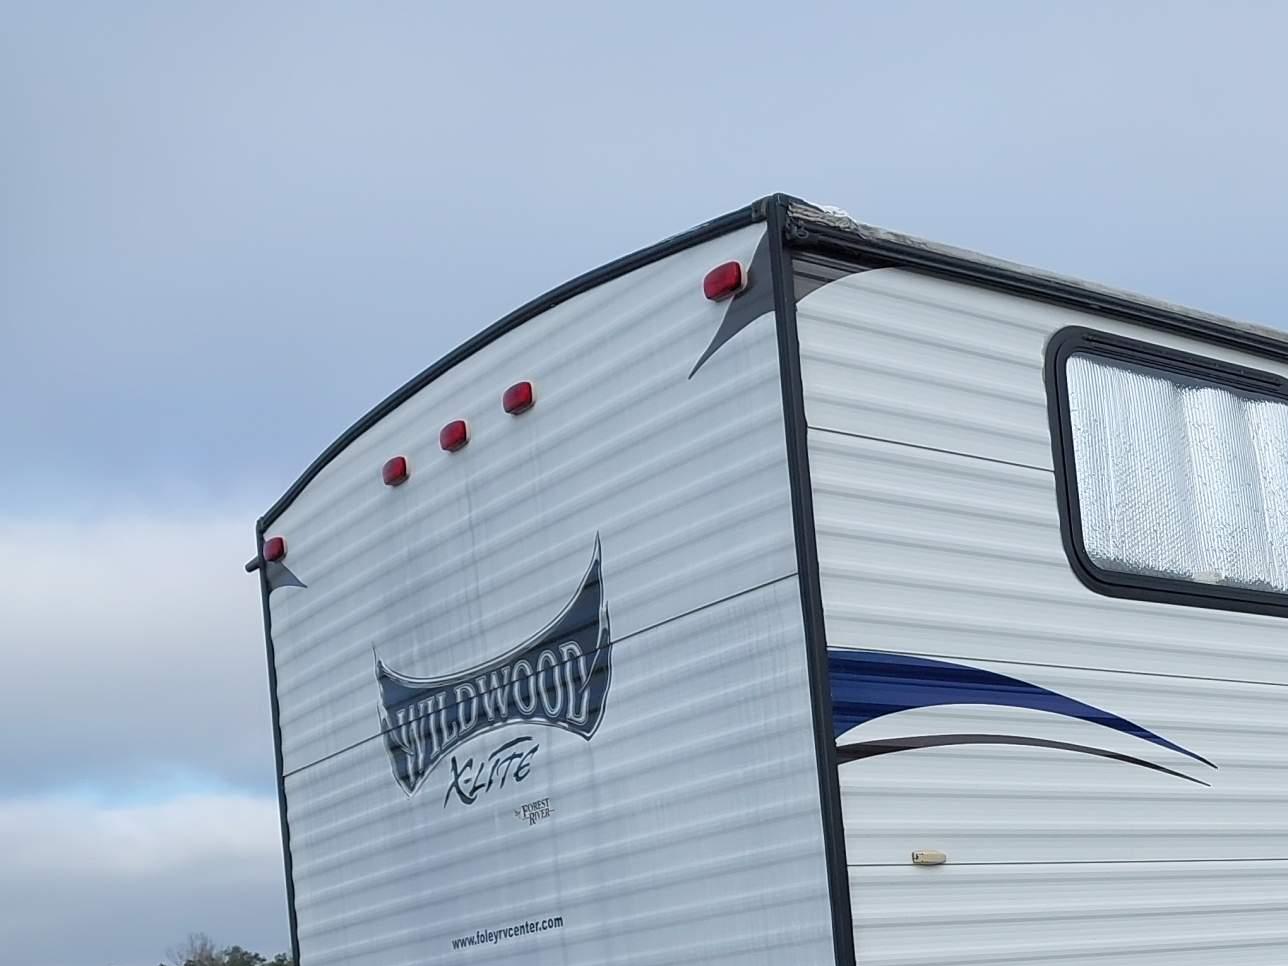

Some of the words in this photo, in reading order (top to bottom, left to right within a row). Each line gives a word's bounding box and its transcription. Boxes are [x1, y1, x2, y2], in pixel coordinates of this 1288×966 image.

[383, 640, 591, 788] WILDWOOD
[444, 736, 540, 808] X-LITE
[521, 798, 551, 818] FOREST
[529, 808, 551, 826] RIVER
[452, 916, 563, 950] www.foleyrvcenter.com
